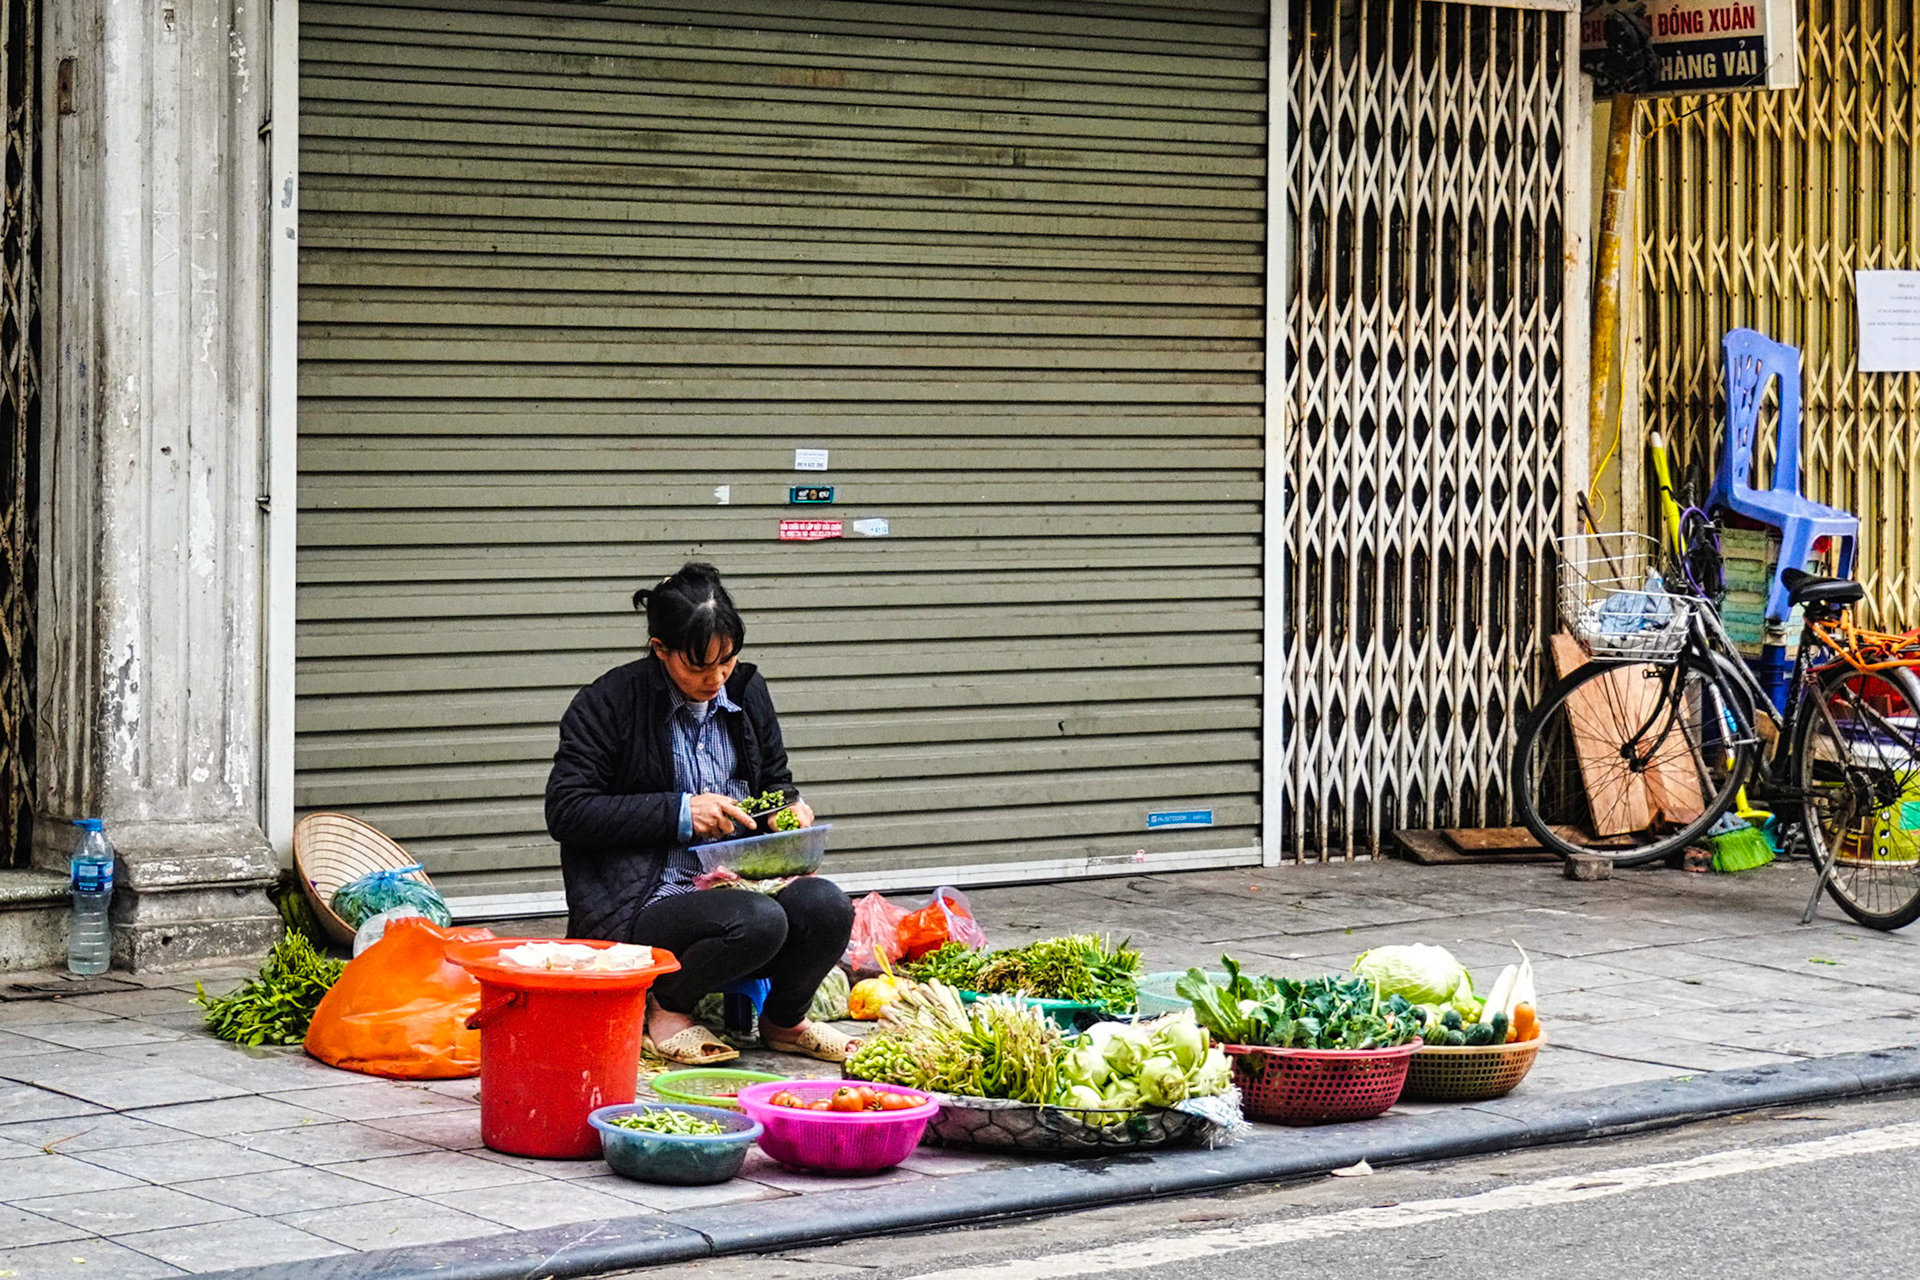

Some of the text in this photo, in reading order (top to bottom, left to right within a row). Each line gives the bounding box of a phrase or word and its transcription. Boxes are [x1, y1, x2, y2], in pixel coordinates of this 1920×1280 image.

[1658, 4, 1702, 36] ĐỒNG
[1709, 2, 1755, 32] XUÂN
[1660, 39, 1757, 82] HÀNG VẢI
